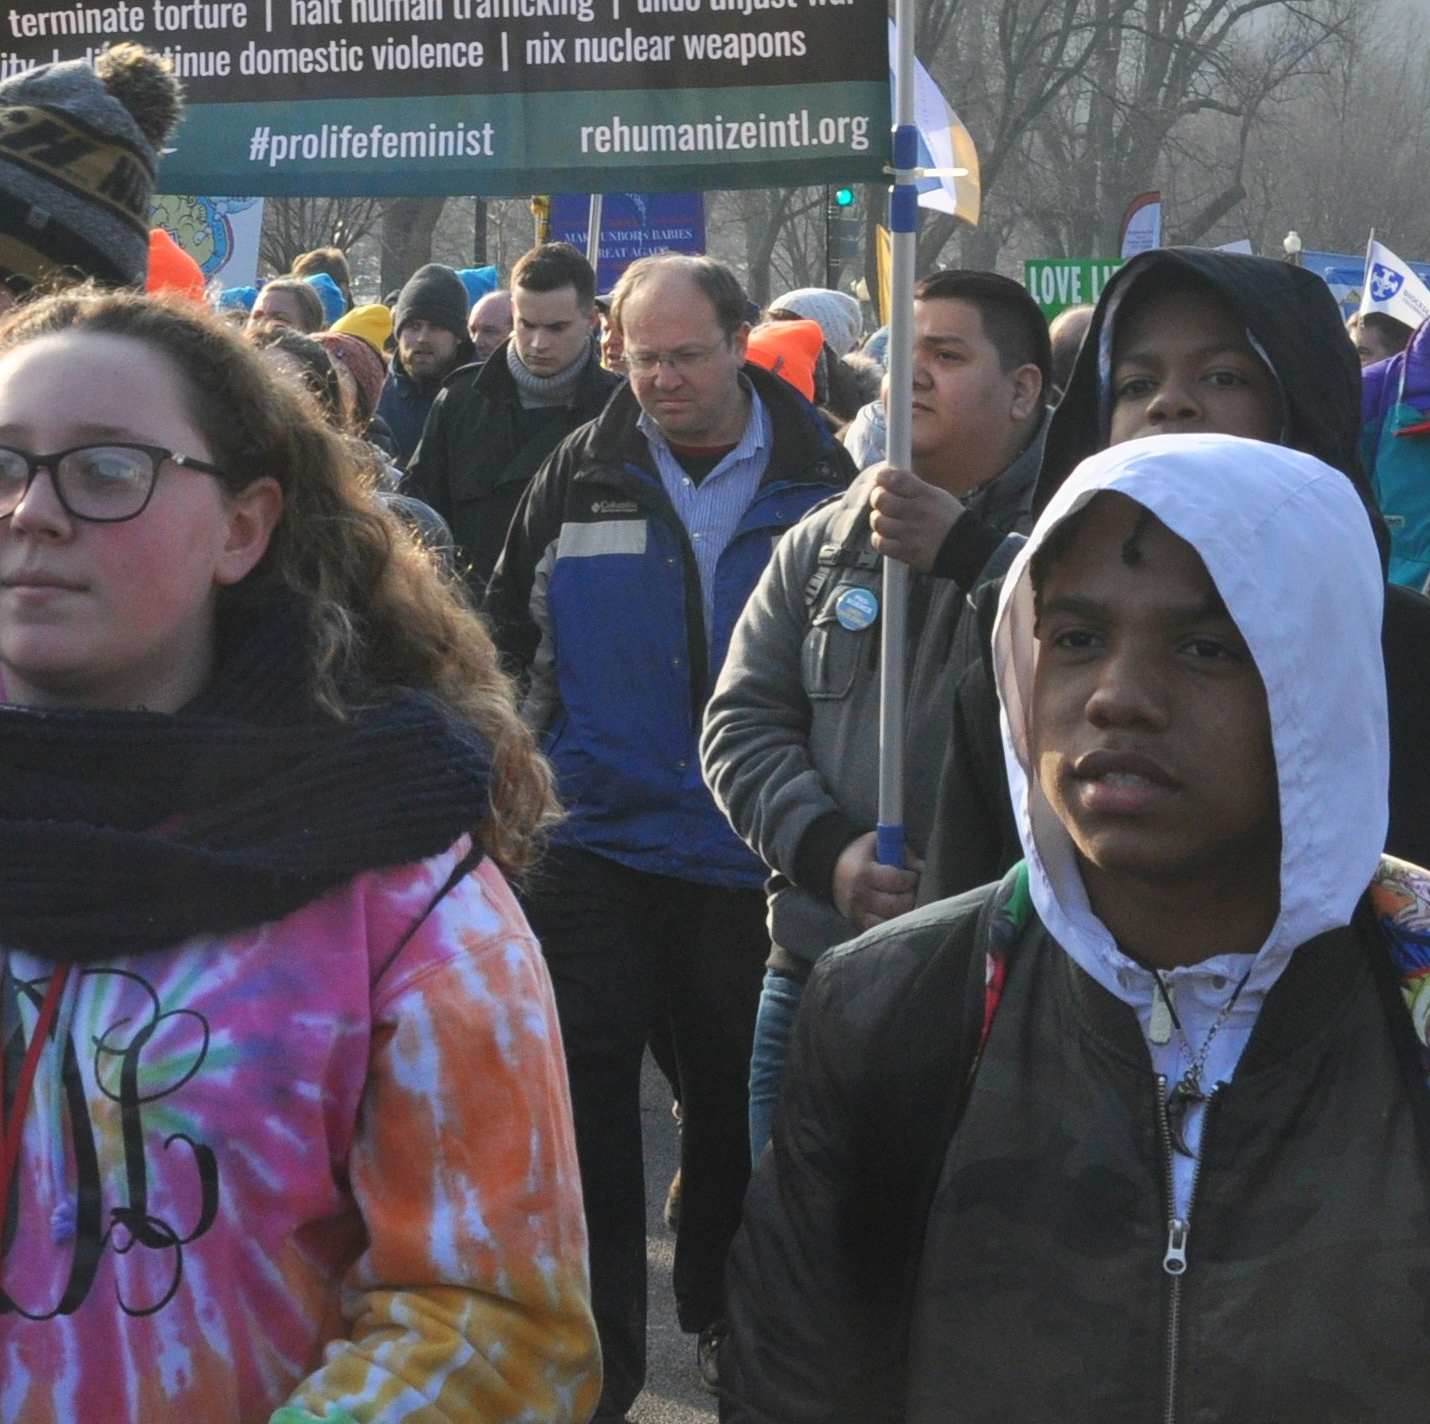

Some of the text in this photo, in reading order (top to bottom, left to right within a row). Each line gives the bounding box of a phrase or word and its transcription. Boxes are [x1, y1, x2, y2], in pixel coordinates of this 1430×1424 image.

[8, 0, 144, 39] terminate
[239, 38, 364, 76] domestic
[371, 35, 484, 69] violence
[525, 30, 566, 66] nix
[574, 28, 674, 63] nuclear
[683, 29, 807, 66] weapons
[249, 122, 494, 166] #prolifefeminist
[581, 109, 869, 153] rehumanizeintl.org
[598, 247, 626, 259] REAT
[1029, 265, 1082, 305] LOVE
